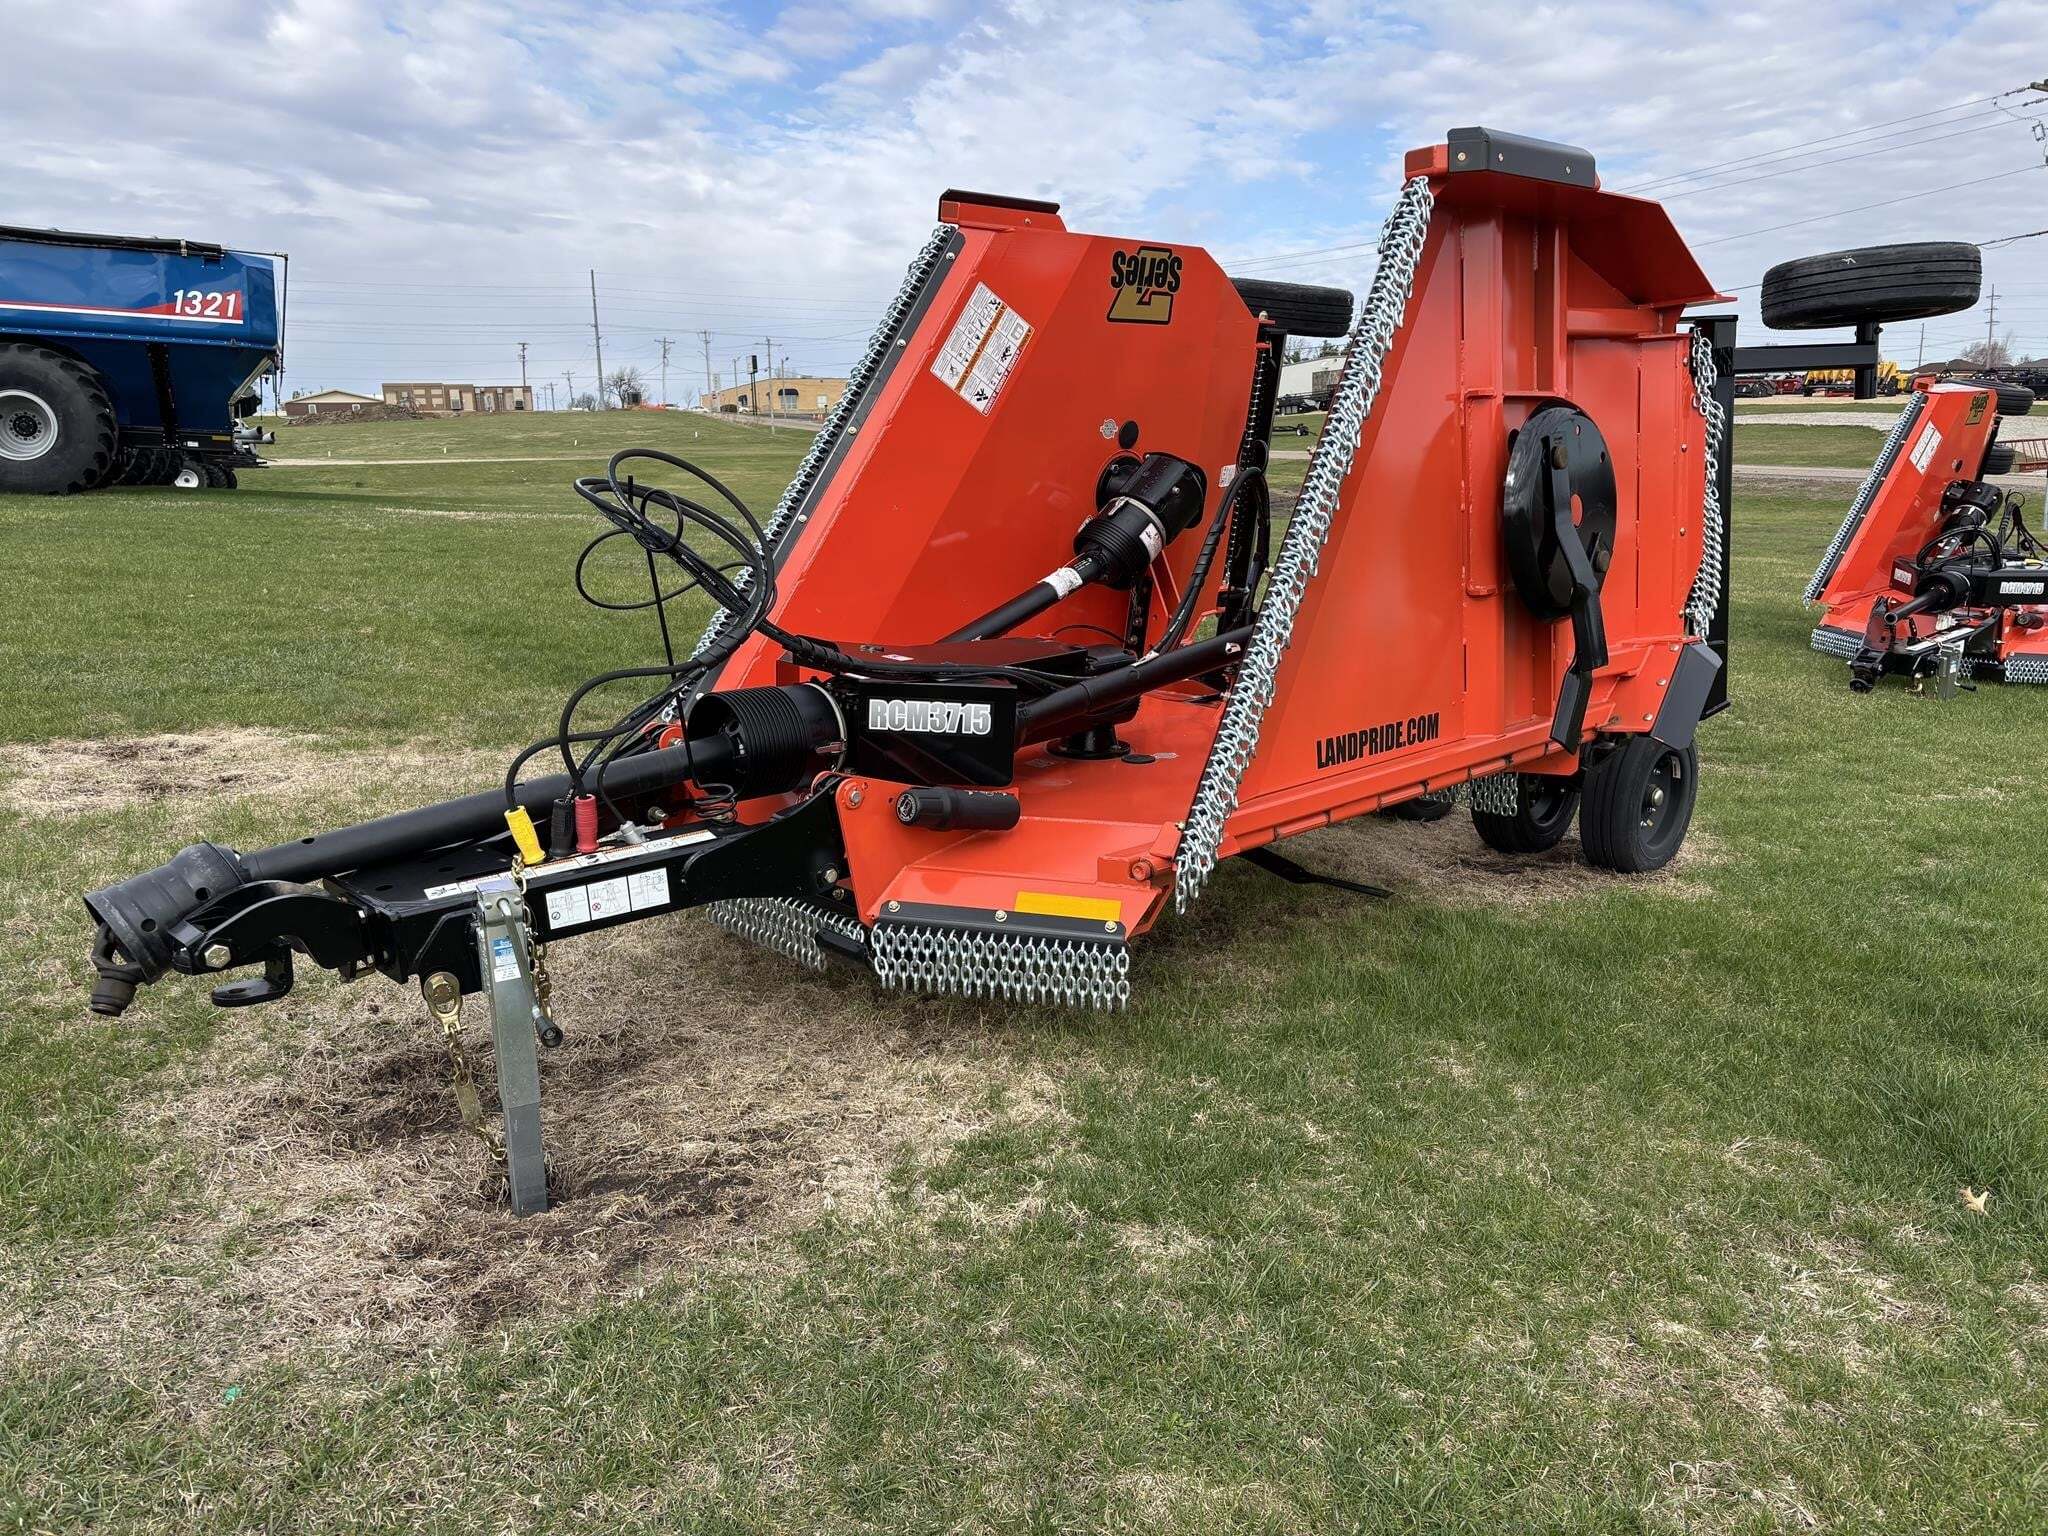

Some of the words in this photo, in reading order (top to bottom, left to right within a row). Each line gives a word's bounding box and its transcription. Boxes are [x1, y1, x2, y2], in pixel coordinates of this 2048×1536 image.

[1111, 251, 1183, 293] Series
[174, 289, 236, 317] 1321
[869, 699, 991, 735] RCM3715
[1317, 712, 1439, 769] LANDPRIDE.COM
